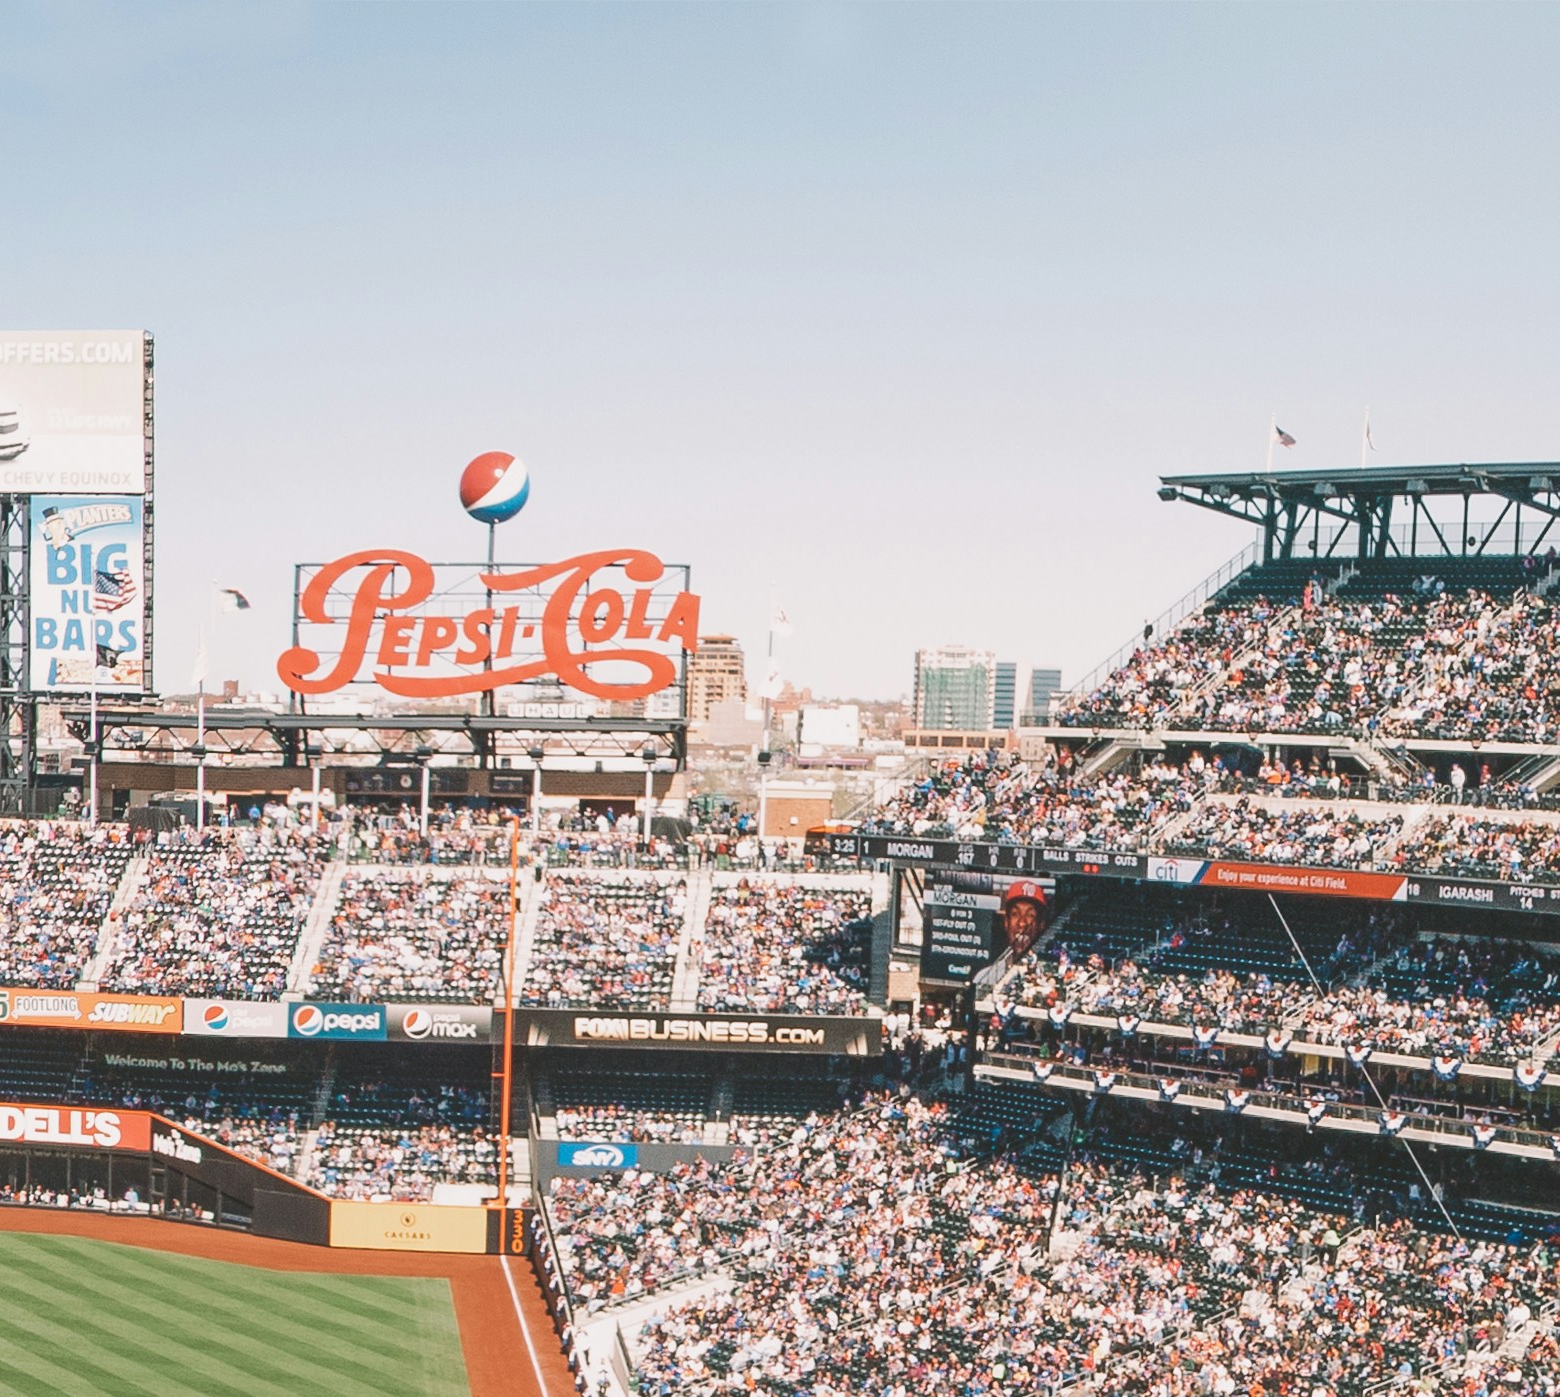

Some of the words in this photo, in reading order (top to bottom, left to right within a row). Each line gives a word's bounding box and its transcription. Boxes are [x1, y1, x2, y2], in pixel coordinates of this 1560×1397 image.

[3, 471, 55, 485] CHEVY
[60, 471, 132, 485] EQUINOX
[70, 503, 133, 530] PLANTERS
[46, 543, 128, 586] BIG
[35, 617, 137, 652] BARS
[887, 842, 934, 860] MORGAN
[1438, 885, 1493, 902] IGARASHI
[15, 995, 78, 1013] FOOTLONG
[87, 1000, 176, 1025] SUBWAY
[324, 1013, 381, 1032] pepsi
[432, 1023, 478, 1038] max
[105, 1053, 168, 1070] Welcome
[384, 1231, 432, 1241] CAESARS
